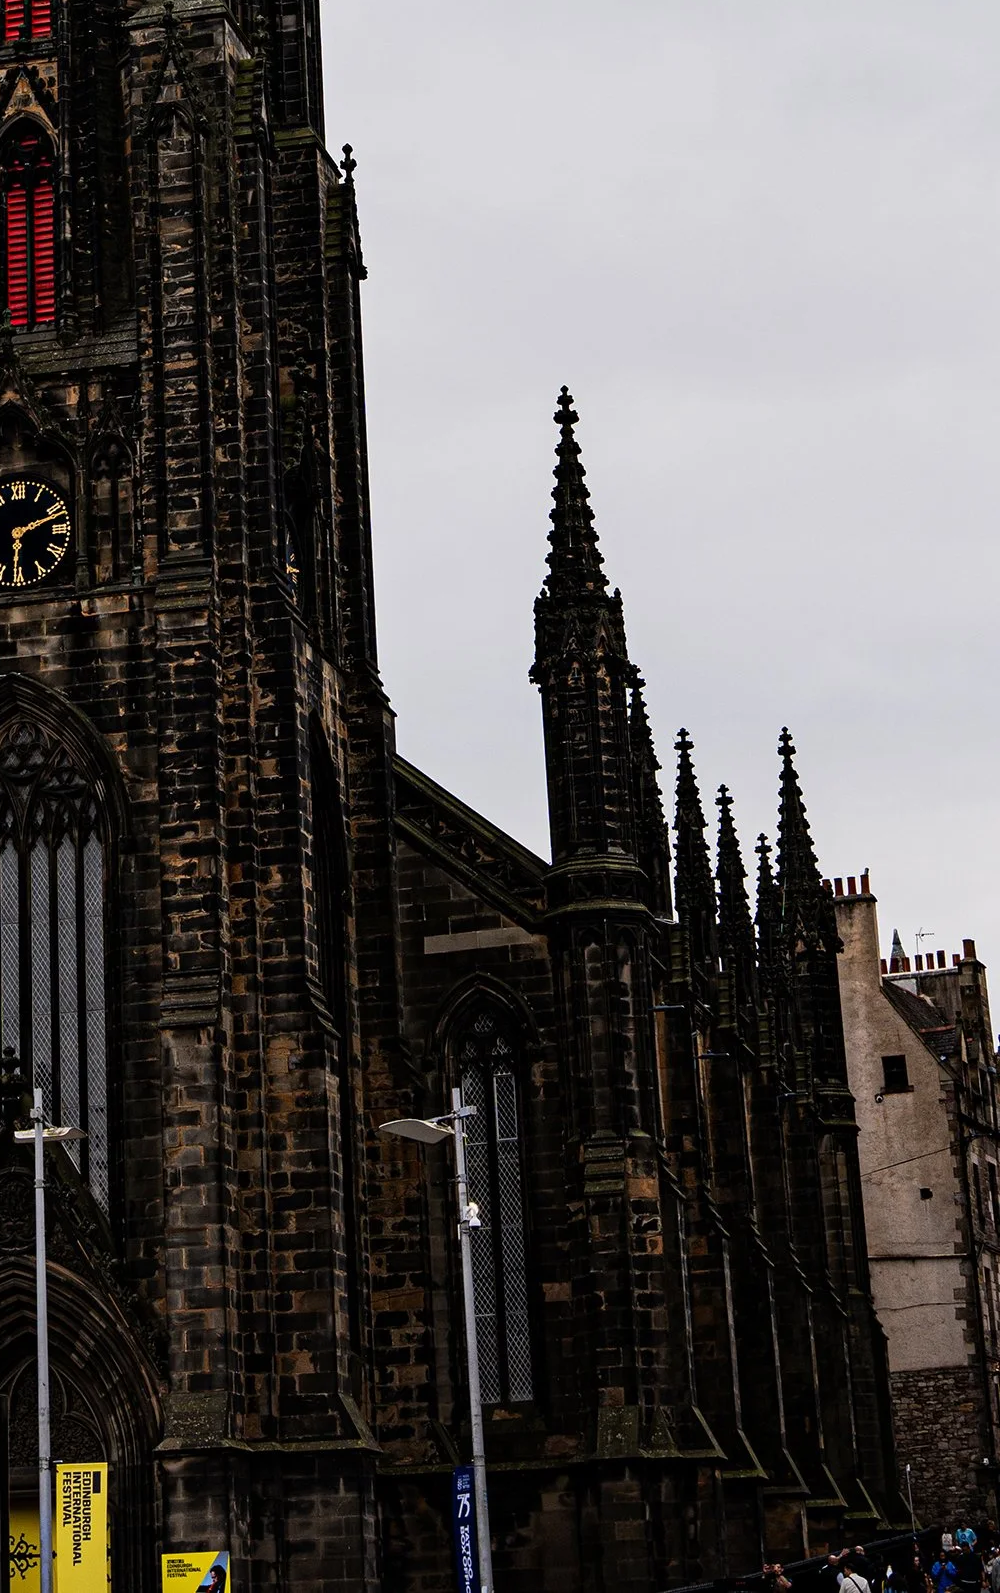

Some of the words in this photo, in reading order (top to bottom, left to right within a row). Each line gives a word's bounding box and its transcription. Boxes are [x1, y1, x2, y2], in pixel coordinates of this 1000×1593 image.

[11, 485, 26, 500] XII
[62, 1472, 72, 1527] FESTIVAL
[72, 1471, 82, 1566] INTERNATIONAL
[82, 1471, 91, 1541] EDINBURGH
[465, 1525, 474, 1579] TATTOO
